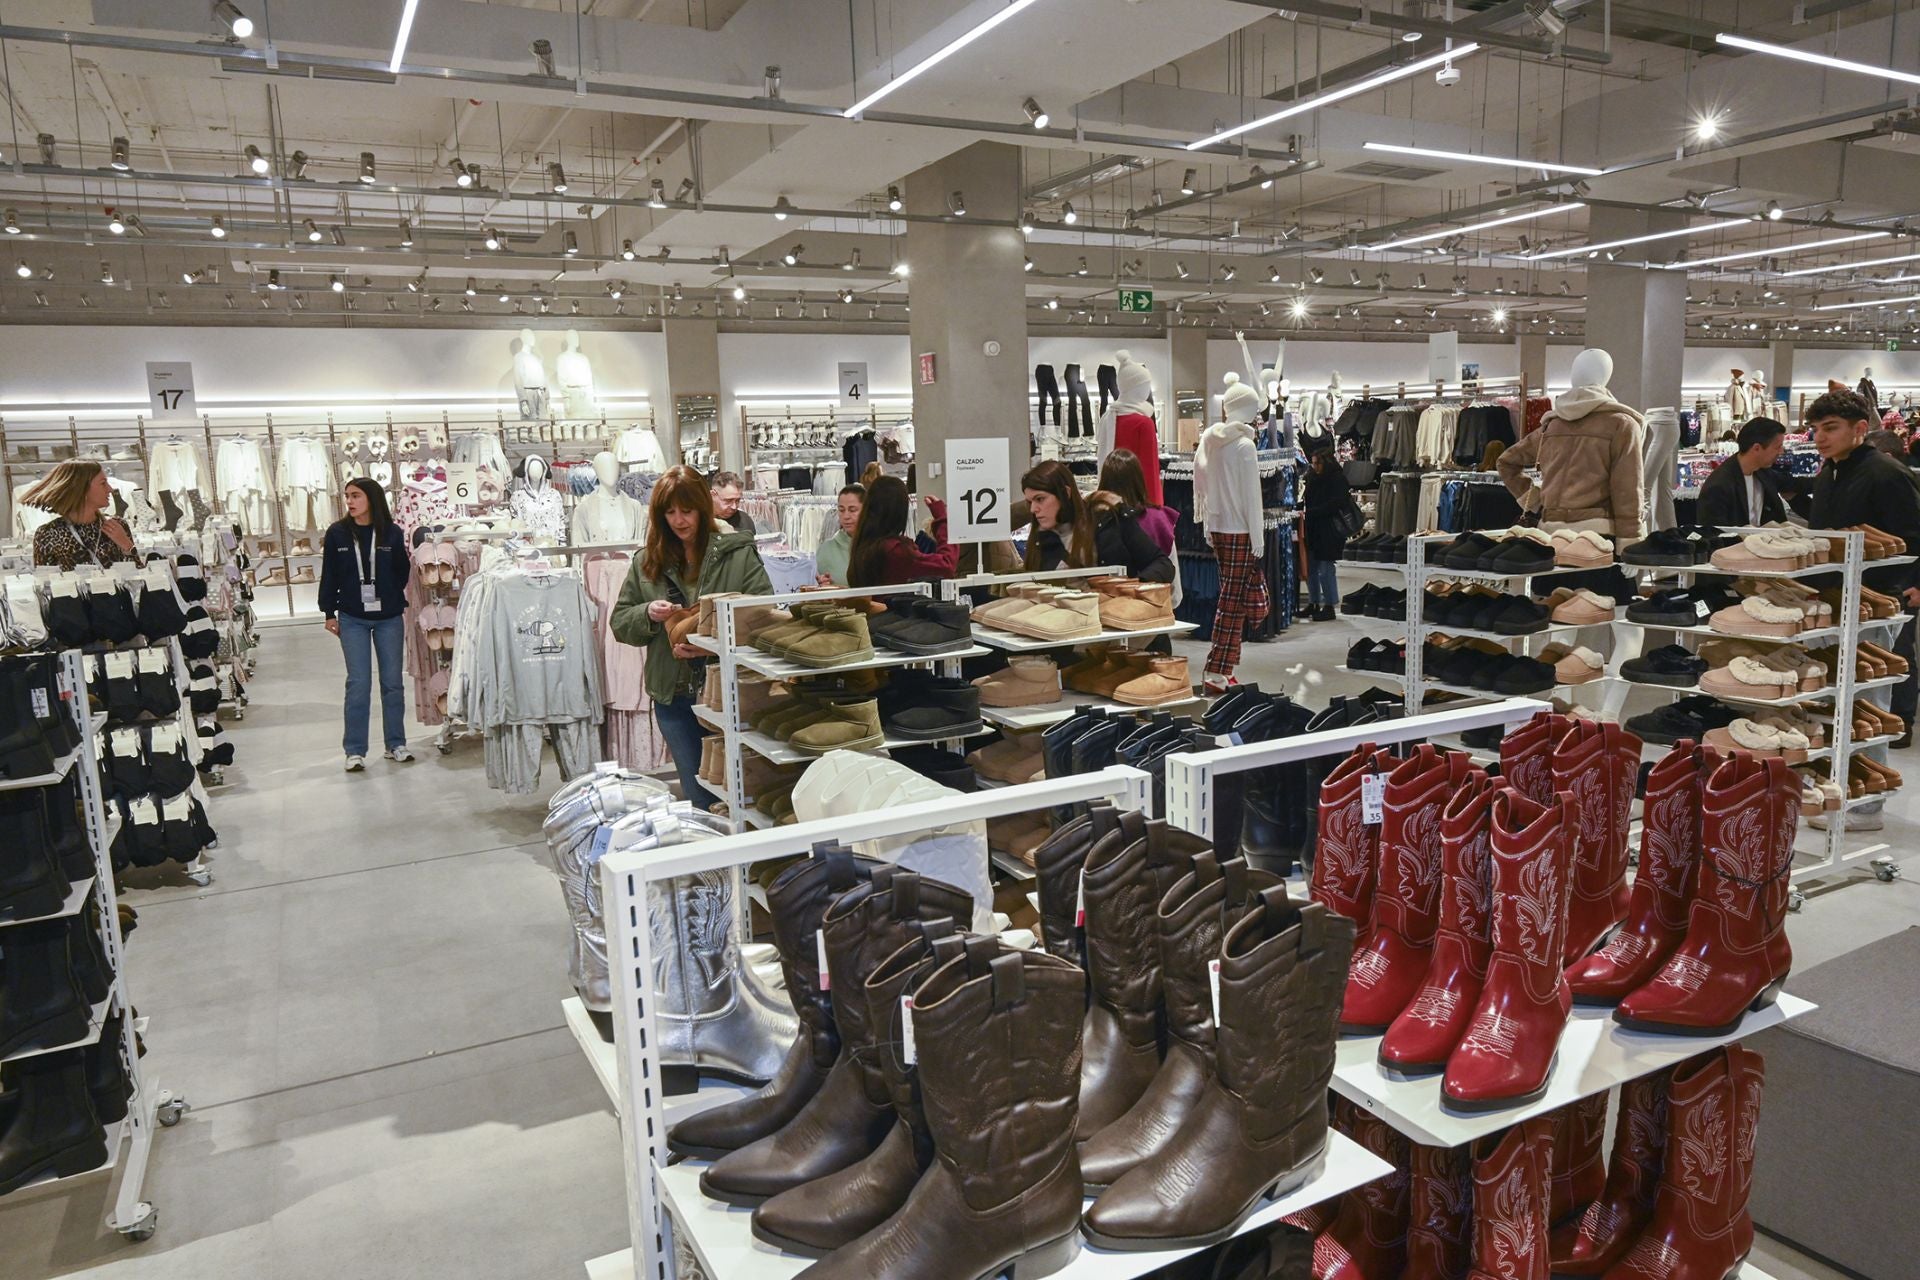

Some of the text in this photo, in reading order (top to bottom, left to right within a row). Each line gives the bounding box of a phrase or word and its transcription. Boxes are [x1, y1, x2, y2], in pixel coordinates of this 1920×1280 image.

[157, 389, 184, 410] 17
[848, 383, 861, 400] 4
[456, 482, 468, 498] 6
[960, 488, 997, 525] 12
[1370, 813, 1381, 822] 35
